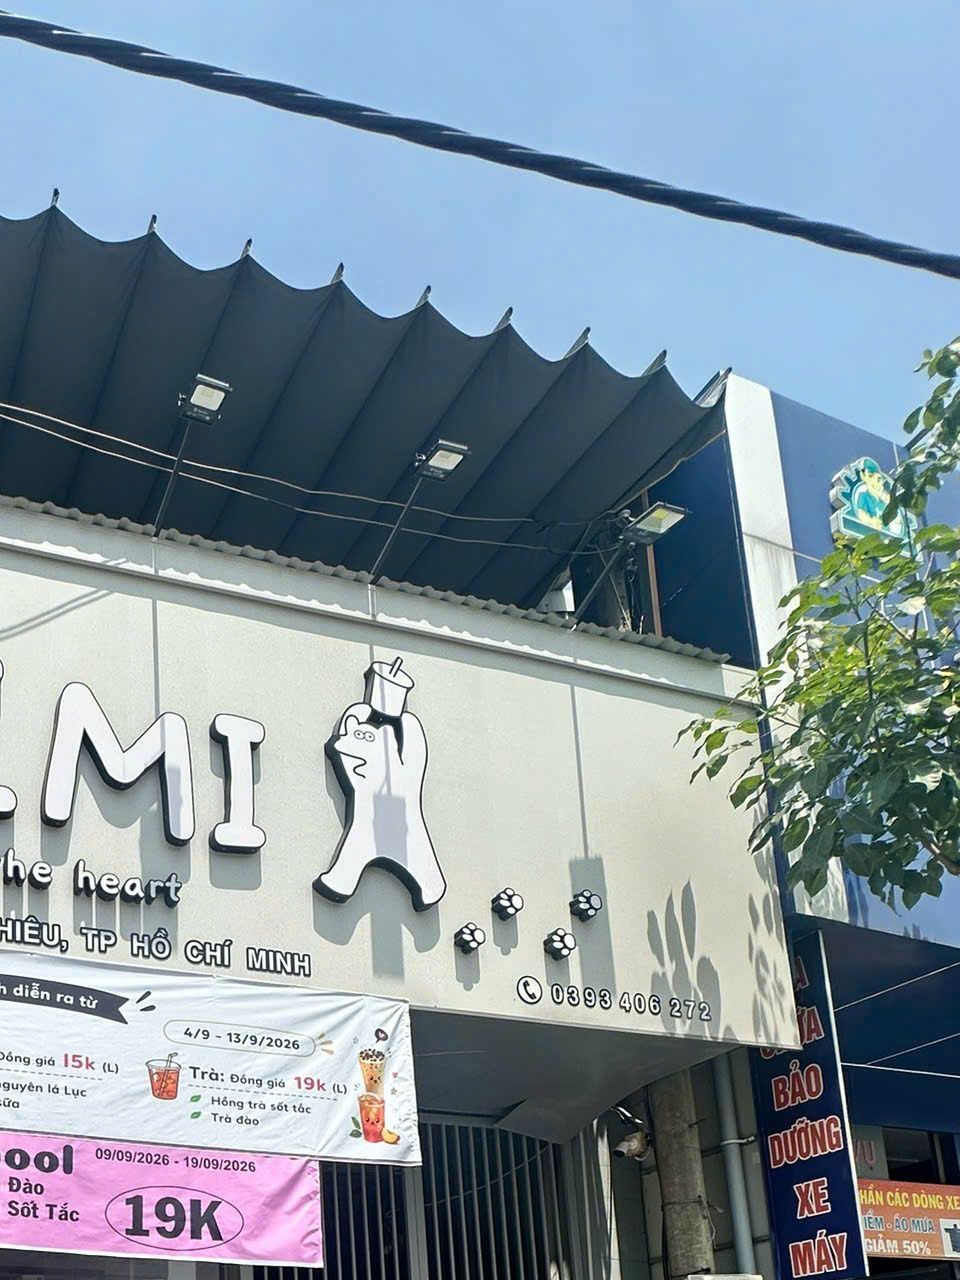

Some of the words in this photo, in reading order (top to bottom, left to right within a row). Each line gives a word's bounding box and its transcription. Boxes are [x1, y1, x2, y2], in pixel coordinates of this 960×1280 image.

[74, 860, 183, 908] heart
[80, 925, 117, 953] TP
[130, 928, 172, 960] HỒ
[184, 939, 233, 968] CHÍ
[246, 946, 313, 977] MINH
[13, 981, 51, 1001] diễn
[55, 992, 75, 1006] ra
[79, 994, 99, 1010] từ
[551, 983, 613, 1009] 0393
[619, 991, 662, 1016] 406
[669, 995, 712, 1022] 272
[183, 1027, 211, 1041] 4/9
[227, 1032, 301, 1051] 13/9/2026
[35, 1055, 56, 1068] giá
[102, 1062, 120, 1075] (L)
[47, 1083, 60, 1095] lá
[64, 1085, 87, 1099] Lục
[189, 1065, 225, 1083] Trà:
[230, 1073, 263, 1089] Đồng
[267, 1077, 286, 1090] giá
[294, 1075, 327, 1092] 19k
[332, 1082, 348, 1096] (L)
[771, 1059, 824, 1111] BẢO
[211, 1095, 244, 1111] Hồng
[248, 1099, 267, 1111] trà
[270, 1101, 289, 1113] sốt
[293, 1102, 312, 1115] tắc
[211, 1112, 232, 1124] Trà
[236, 1113, 260, 1127] đào
[768, 1115, 844, 1168] DƯỠNG
[95, 1147, 170, 1166] 09/09/2026
[183, 1155, 257, 1173] 19/09/2026
[8, 1176, 45, 1195] Đào
[793, 1177, 831, 1220] XE
[886, 1188, 910, 1207] CÁC
[912, 1189, 944, 1210] DÒNG
[7, 1199, 39, 1219] Sốt
[44, 1202, 80, 1222] Tắc
[123, 1194, 225, 1242] 19K
[789, 1229, 847, 1278] MÁY
[864, 1234, 899, 1254] GIẢM
[902, 1240, 931, 1256] 50%
